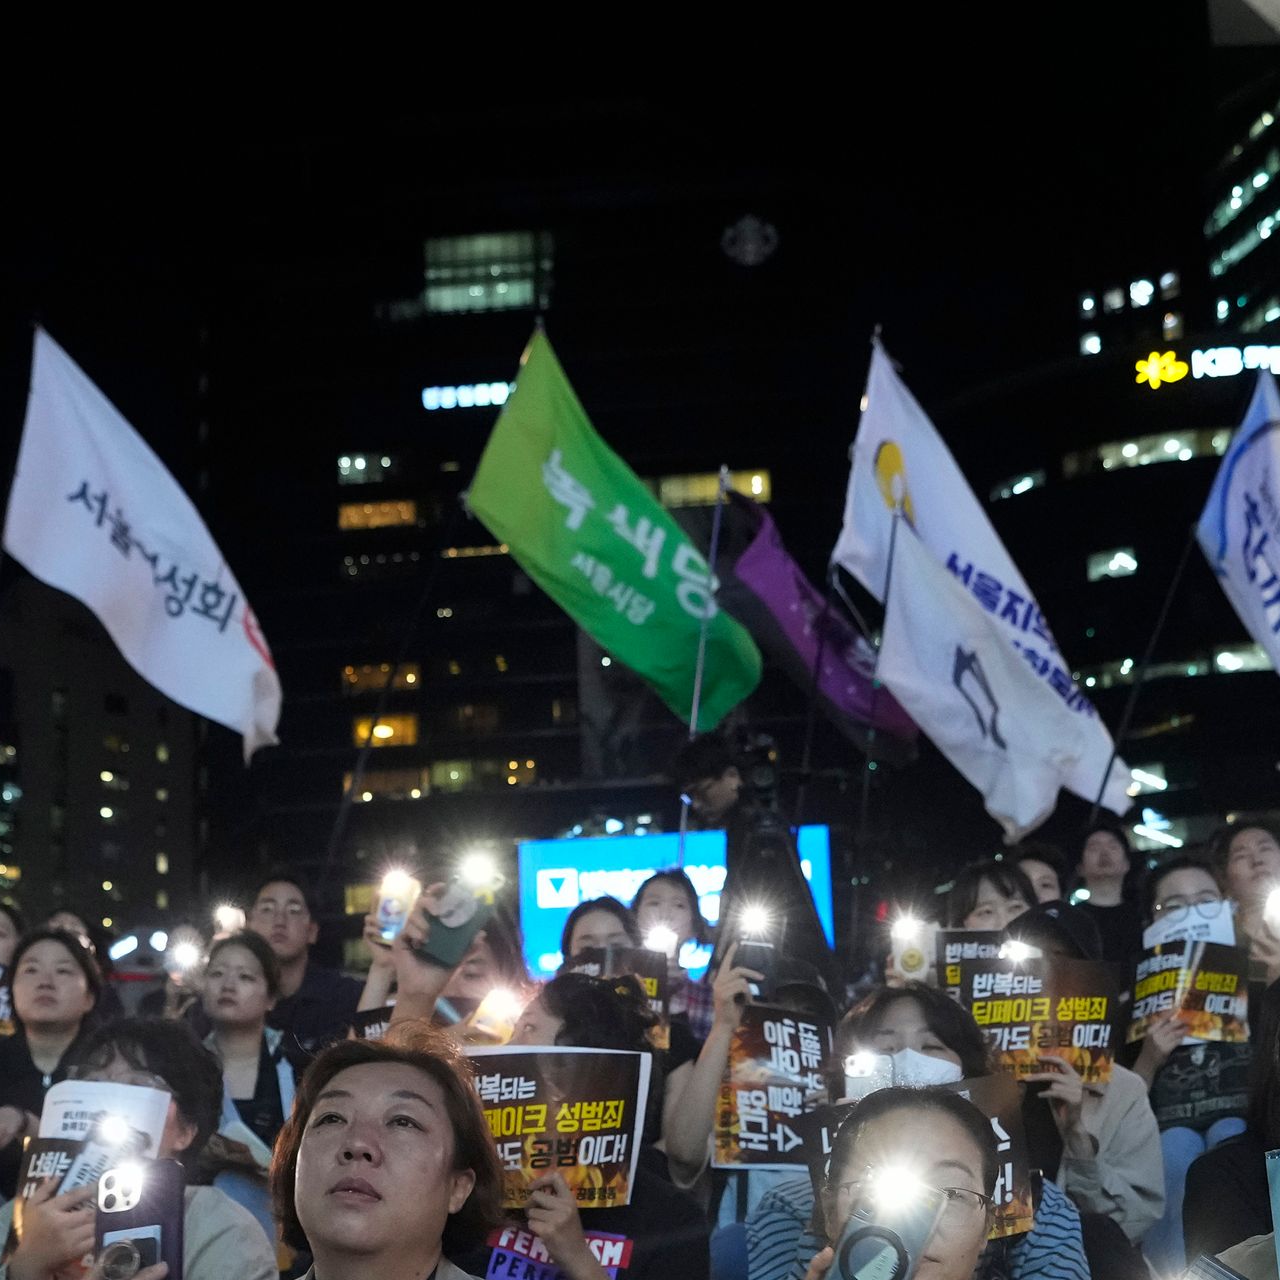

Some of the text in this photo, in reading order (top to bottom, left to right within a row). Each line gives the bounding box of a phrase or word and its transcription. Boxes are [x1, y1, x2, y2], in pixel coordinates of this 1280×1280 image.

[973, 972, 1042, 999] 반복되는
[973, 996, 1108, 1027] 딥페이크 성범죄
[484, 1100, 625, 1137] 페이크 성범죄
[530, 1133, 628, 1169] 공범이다!
